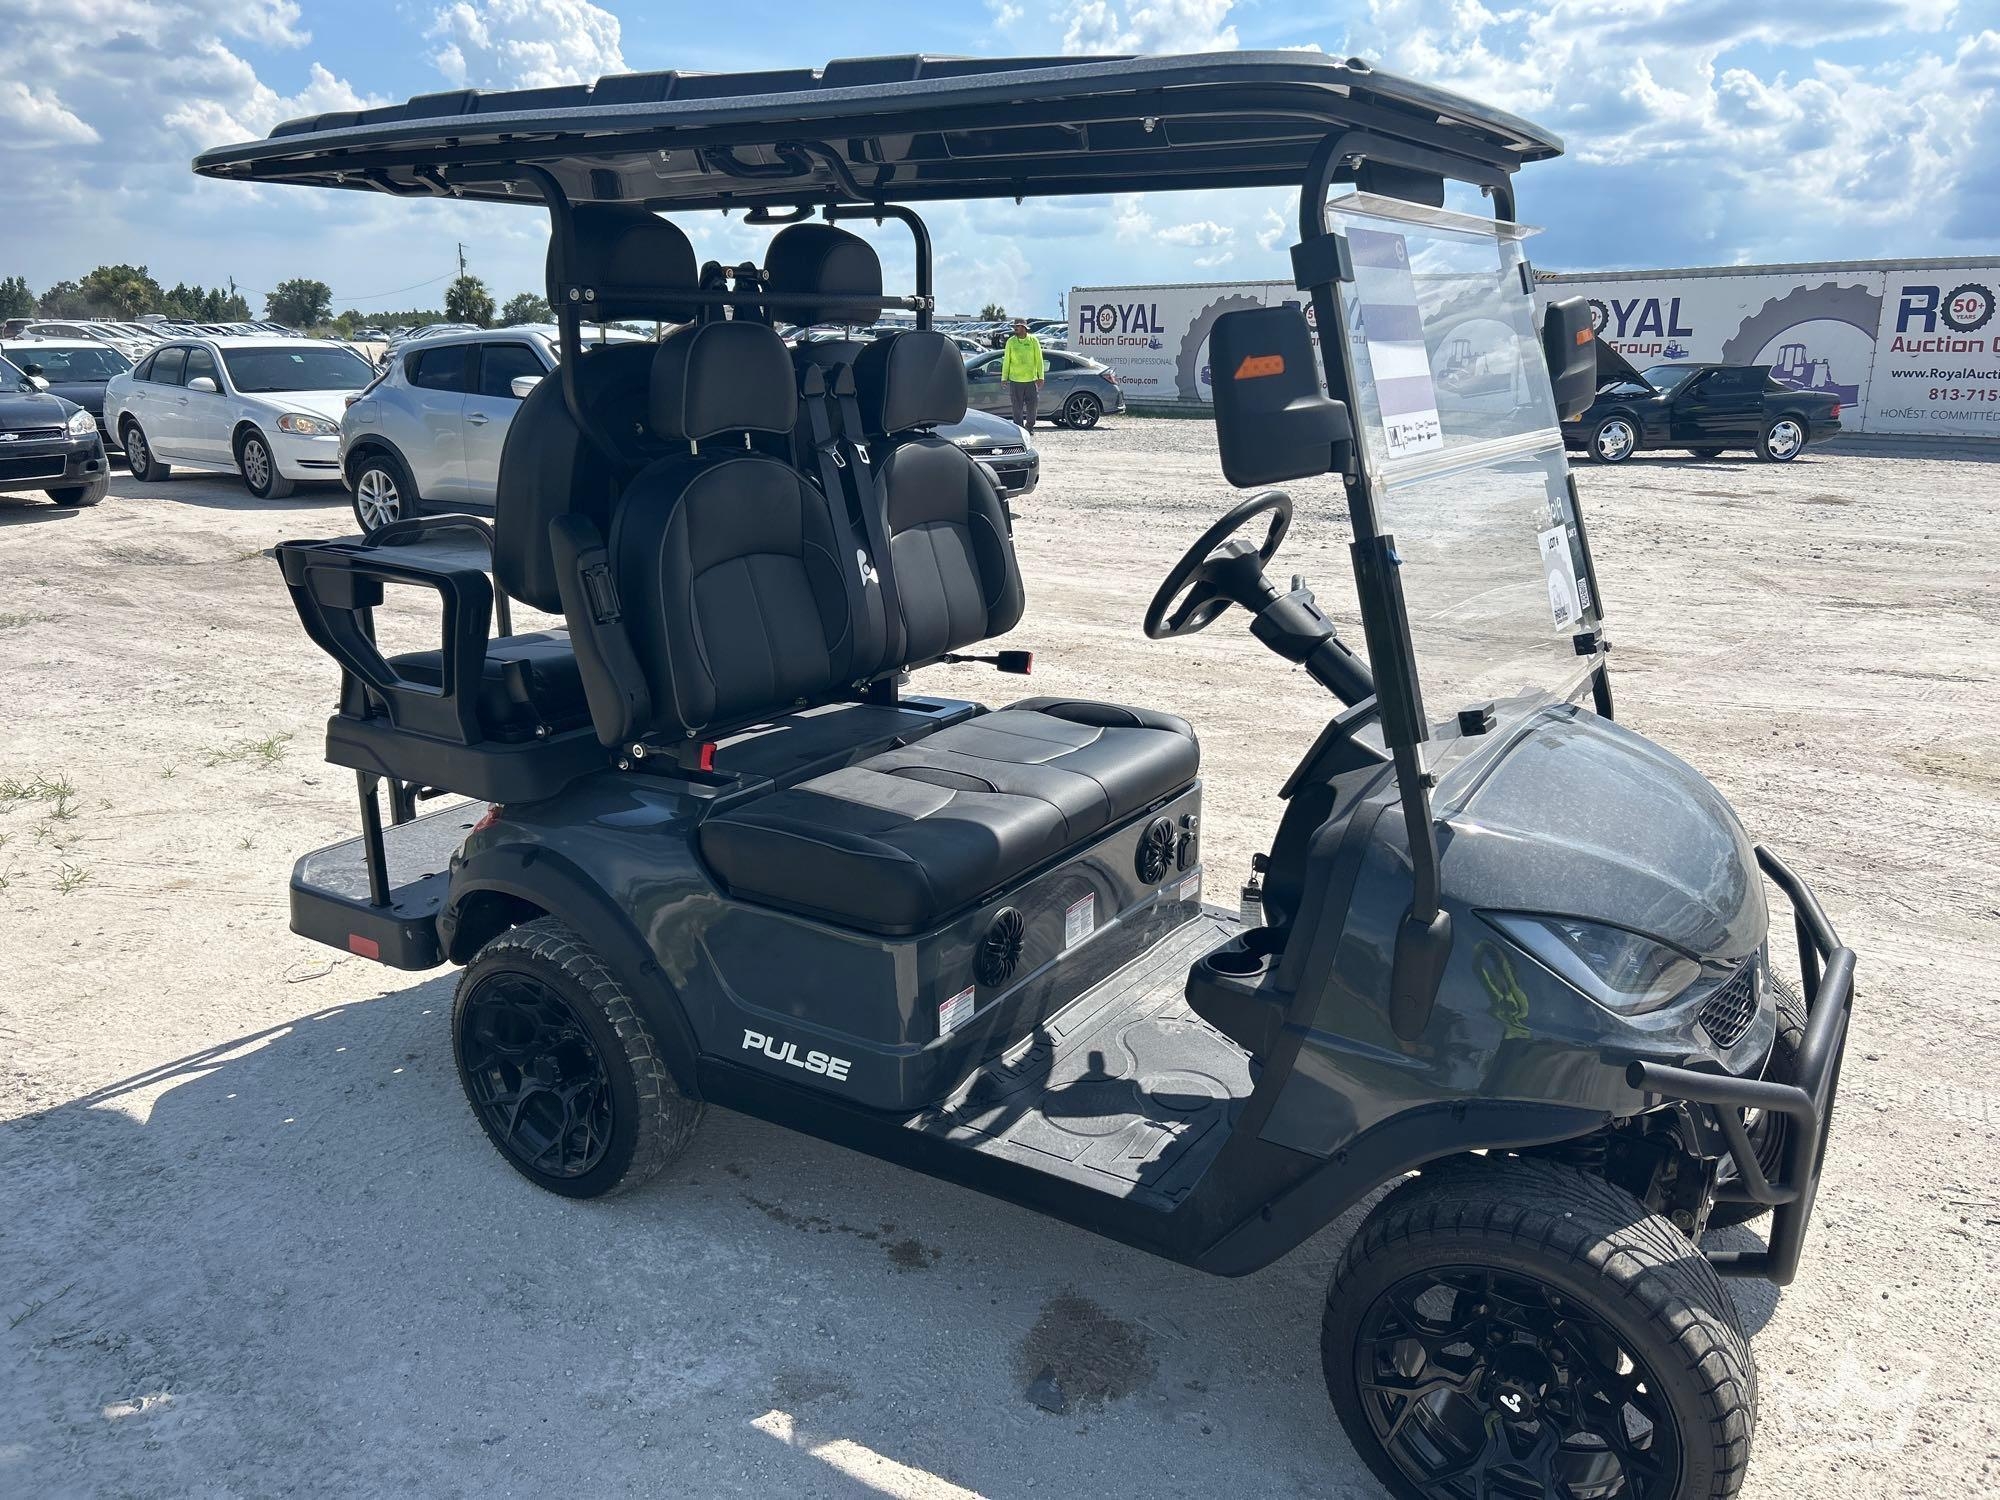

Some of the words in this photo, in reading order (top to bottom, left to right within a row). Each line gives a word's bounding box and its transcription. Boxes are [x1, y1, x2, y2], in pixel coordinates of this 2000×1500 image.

[1953, 298, 1985, 313] 50+
[1080, 304, 1164, 333] ROYAL
[1079, 336, 1114, 345] Auction
[1118, 336, 1148, 348] Group
[1890, 336, 1985, 352] Auction
[1929, 388, 2000, 401] 813-715
[742, 1029, 852, 1081] PULSE
